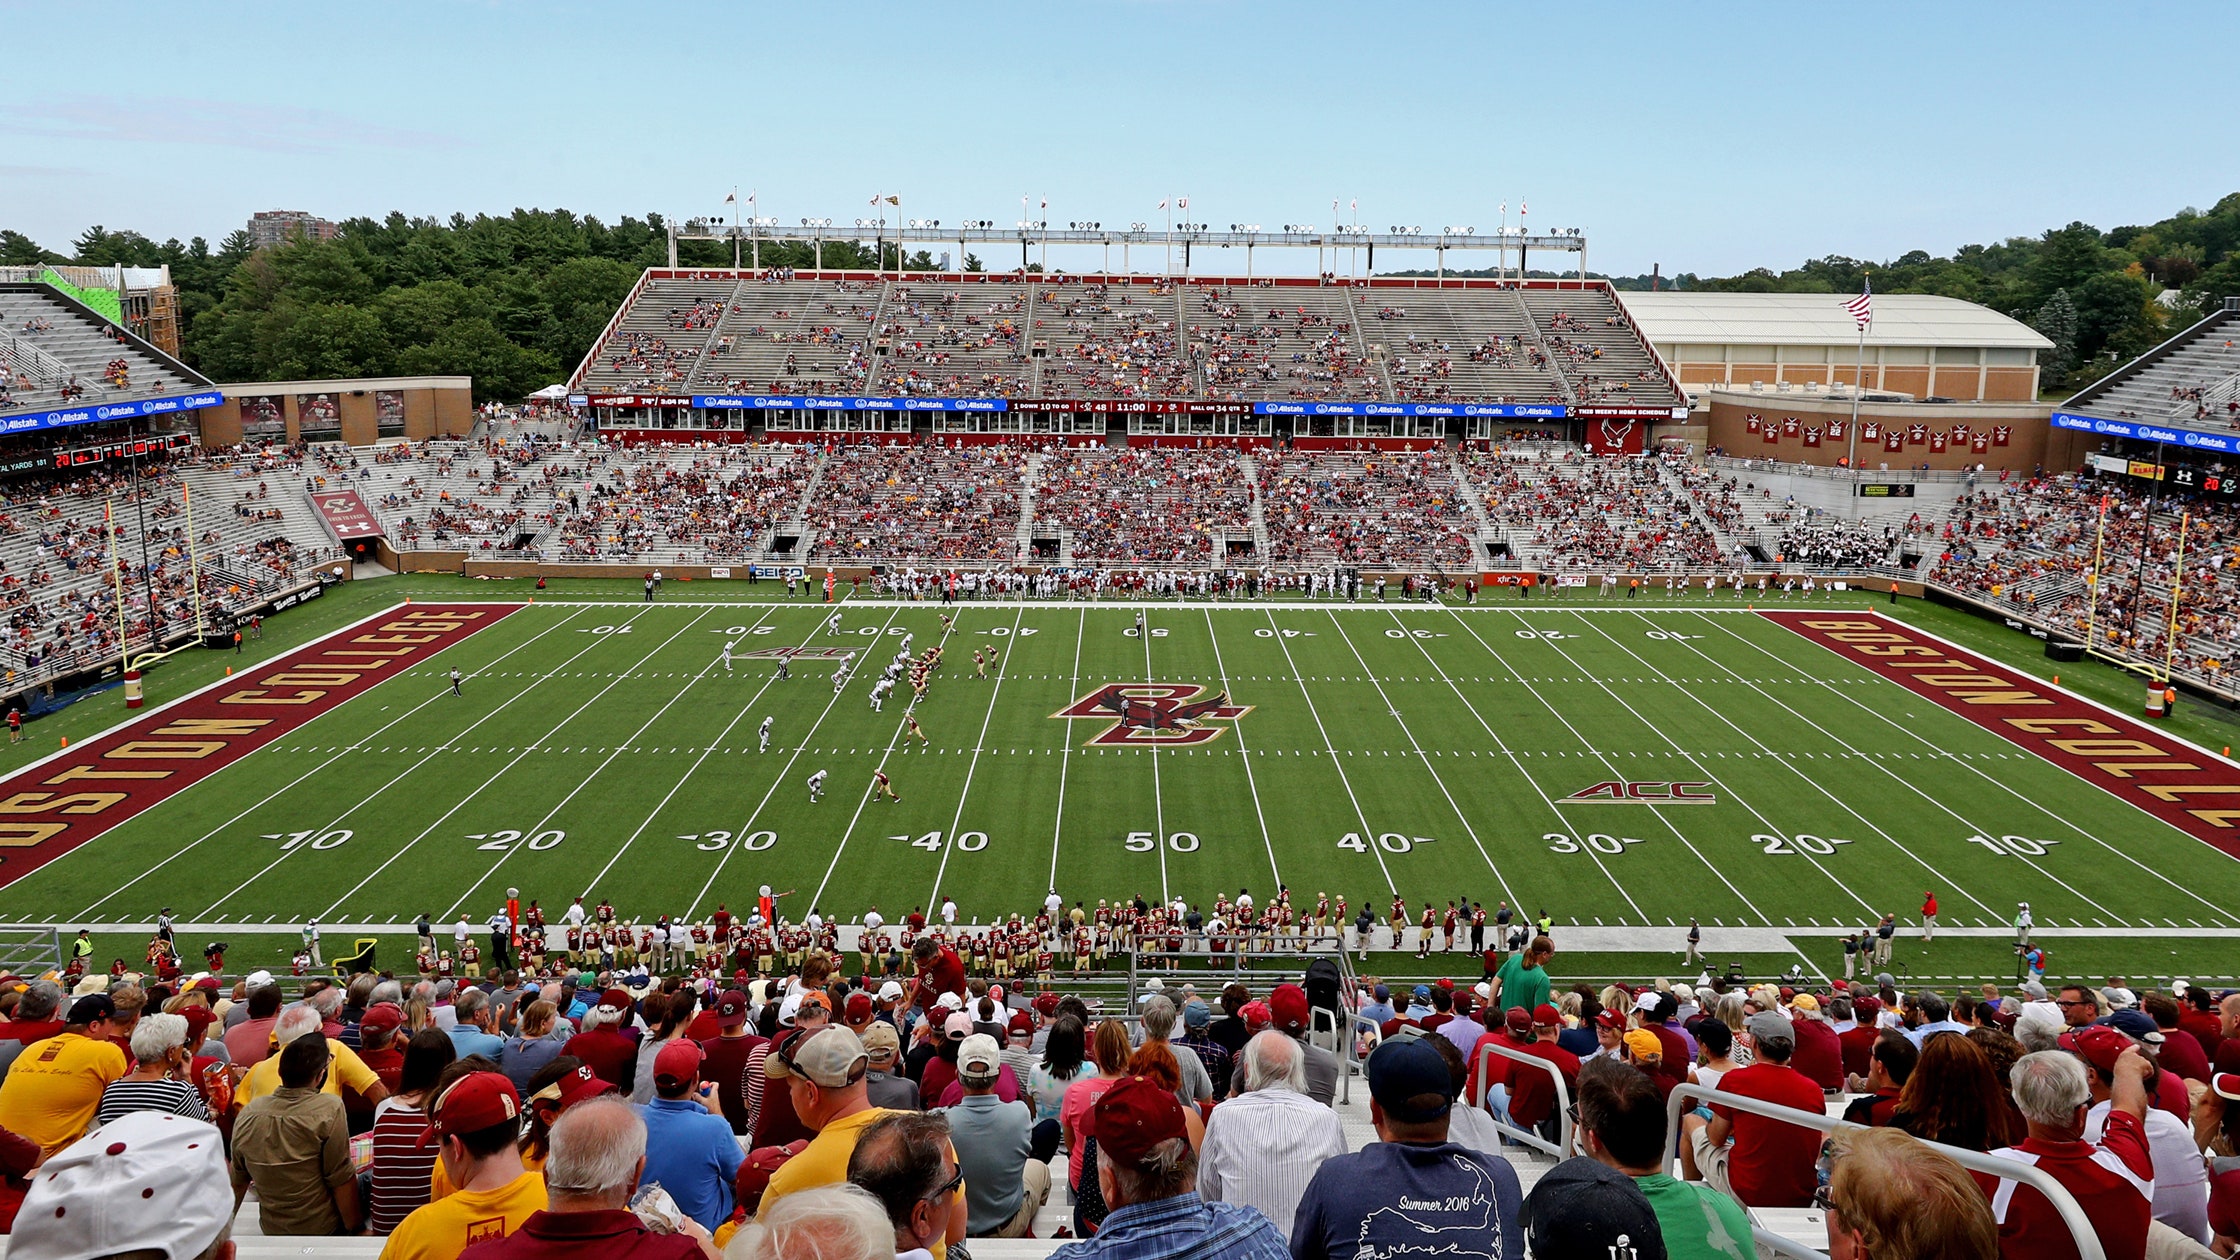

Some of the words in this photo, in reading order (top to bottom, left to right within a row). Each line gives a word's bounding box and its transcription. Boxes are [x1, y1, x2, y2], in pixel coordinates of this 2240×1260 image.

[194, 396, 216, 405] Allstate
[716, 398, 743, 406] Allstate
[766, 398, 794, 407] Allstate
[817, 400, 844, 408] Allstate
[867, 400, 894, 408] Allstate
[917, 401, 944, 409] Allstate
[968, 401, 995, 409] Allstate
[109, 406, 135, 416] Allstate
[154, 402, 177, 411] Allstate
[1117, 403, 1145, 411] 11:00
[1278, 405, 1305, 413] Allstate
[1328, 405, 1354, 413] Allstate
[1378, 406, 1404, 414] Allstate
[1427, 406, 1454, 414] Allstate
[1477, 407, 1503, 415] Allstate
[1526, 407, 1553, 415] Allstate
[61, 412, 89, 423] Allstate
[7, 418, 37, 430] Allstate
[2068, 418, 2091, 429] Allstate
[1829, 428, 1841, 436] 22
[2105, 424, 2131, 435] Allstate
[2150, 430, 2176, 441] Allstate
[2197, 437, 2227, 449] Allstate
[10, 460, 33, 470] YARDS
[56, 454, 70, 467] 20
[2204, 478, 2219, 491] 20
[1497, 575, 1522, 583] xfiny
[1560, 575, 1585, 583] EPN
[219, 611, 487, 705] COLLEGE
[1799, 620, 2057, 705] BOSTON
[1567, 780, 1717, 800] ACC
[278, 829, 355, 851] 10
[475, 830, 567, 851] 20
[696, 830, 779, 852] 30
[910, 831, 990, 852] 40
[1124, 831, 1201, 853] 50
[1336, 832, 1414, 854] 40
[1543, 832, 1626, 855] 30
[1750, 833, 1839, 856] 20
[1966, 834, 2049, 857] 10
[1398, 1195, 1443, 1211] Summer
[1444, 1197, 1470, 1212] 2016
